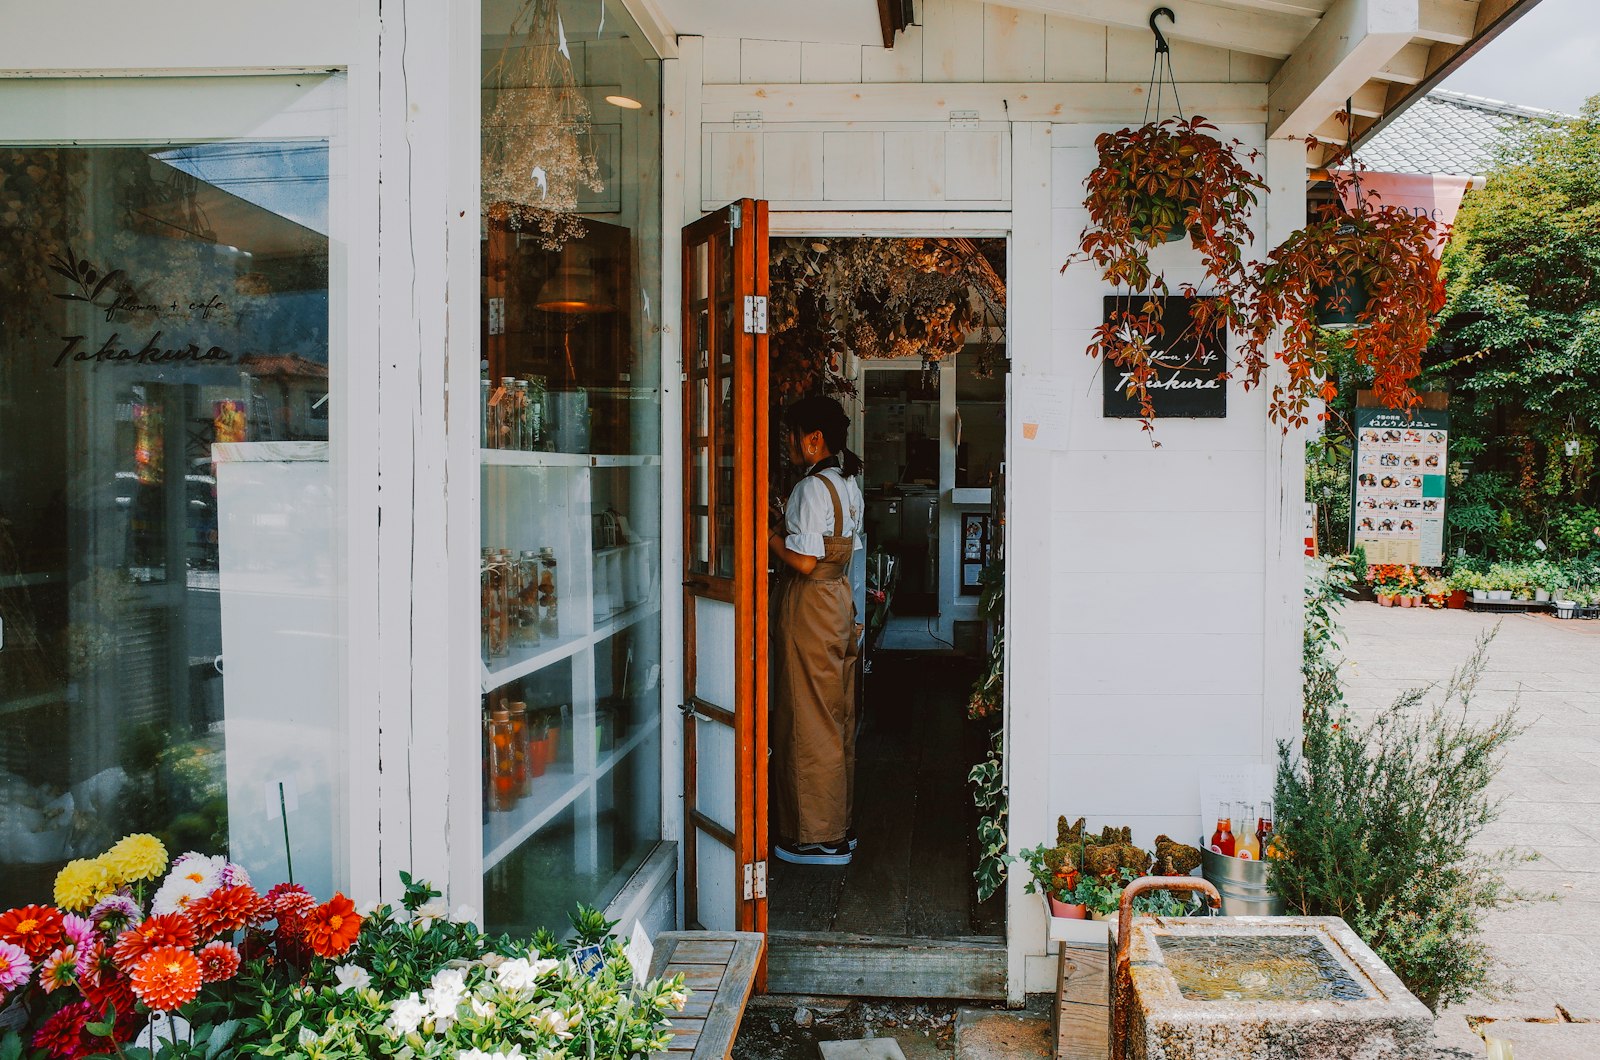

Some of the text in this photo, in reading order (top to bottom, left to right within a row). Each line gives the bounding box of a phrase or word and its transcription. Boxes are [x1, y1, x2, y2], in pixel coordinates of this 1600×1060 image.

[104, 297, 161, 323] flower
[189, 294, 225, 319] cafe
[52, 330, 232, 368] Takakura
[1114, 370, 1220, 392] Takura
